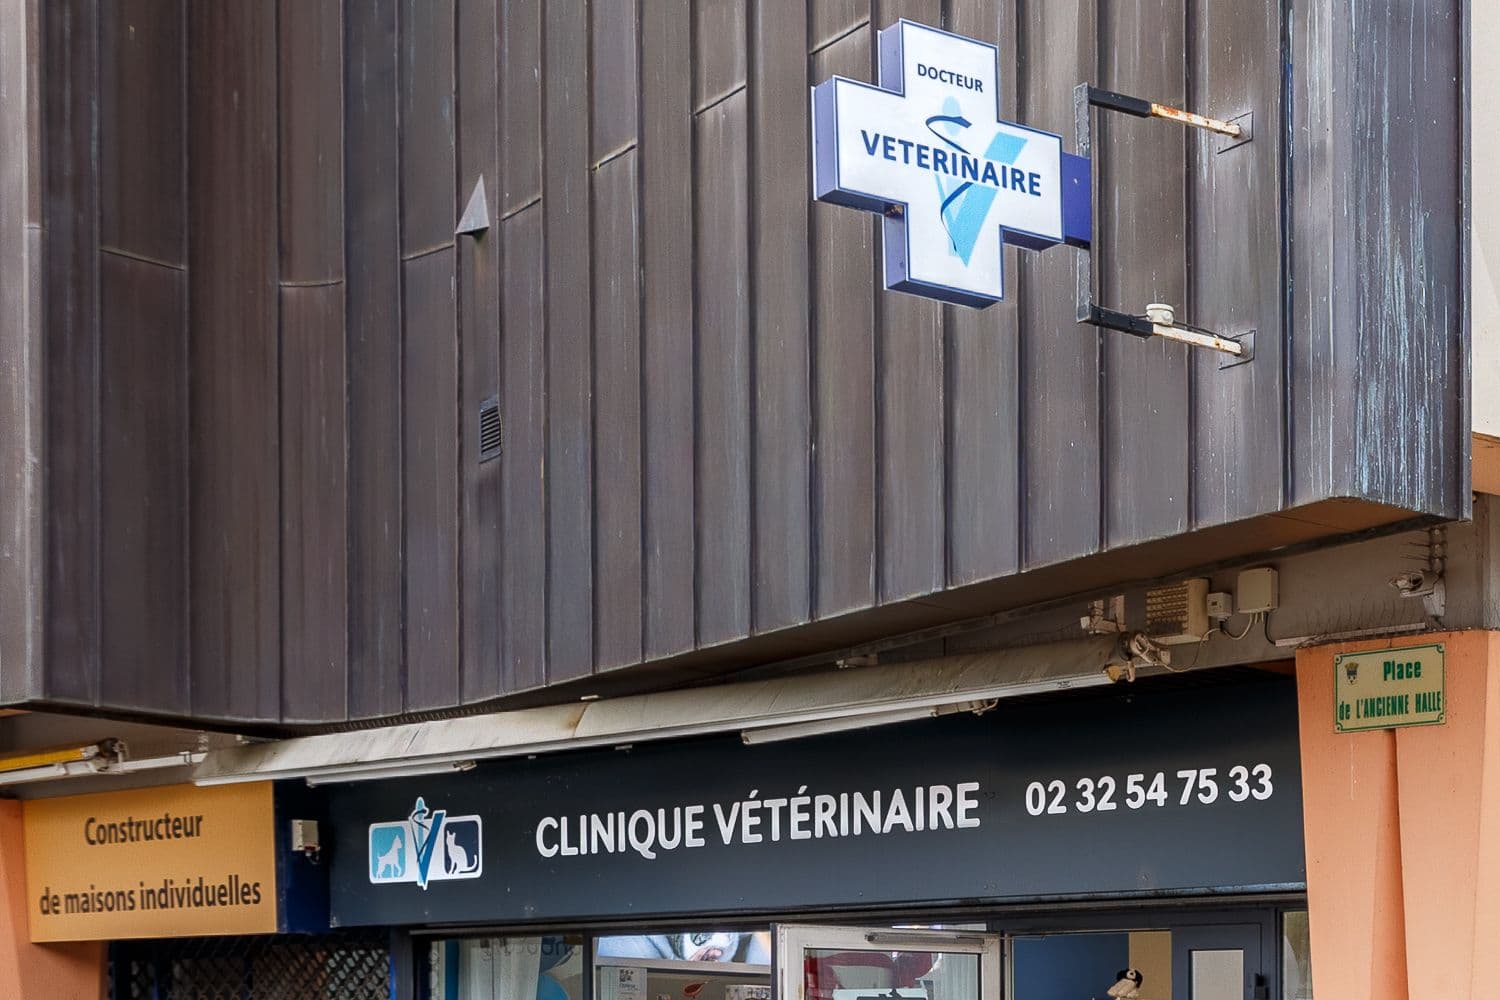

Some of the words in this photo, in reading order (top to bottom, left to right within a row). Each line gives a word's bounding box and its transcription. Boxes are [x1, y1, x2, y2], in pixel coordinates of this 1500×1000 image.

[917, 63, 984, 93] DOCTEUR
[861, 130, 1042, 197] VETERINAIRE
[1383, 661, 1422, 681] Place
[1339, 701, 1351, 721] de
[1356, 694, 1409, 719] L'ANCIENNE
[1415, 691, 1442, 715] HALLE
[536, 804, 706, 859] CLINIQUE
[712, 783, 981, 845] VÉTÉRINAIRE
[1025, 780, 1067, 816] 02
[1075, 776, 1117, 813] 32
[1126, 772, 1168, 810] 54
[1176, 768, 1219, 805] 75
[1228, 763, 1274, 801] 33
[84, 812, 204, 846] Constructeur
[40, 887, 61, 916] de
[64, 884, 136, 914] maisons
[139, 881, 262, 911] individuelles
